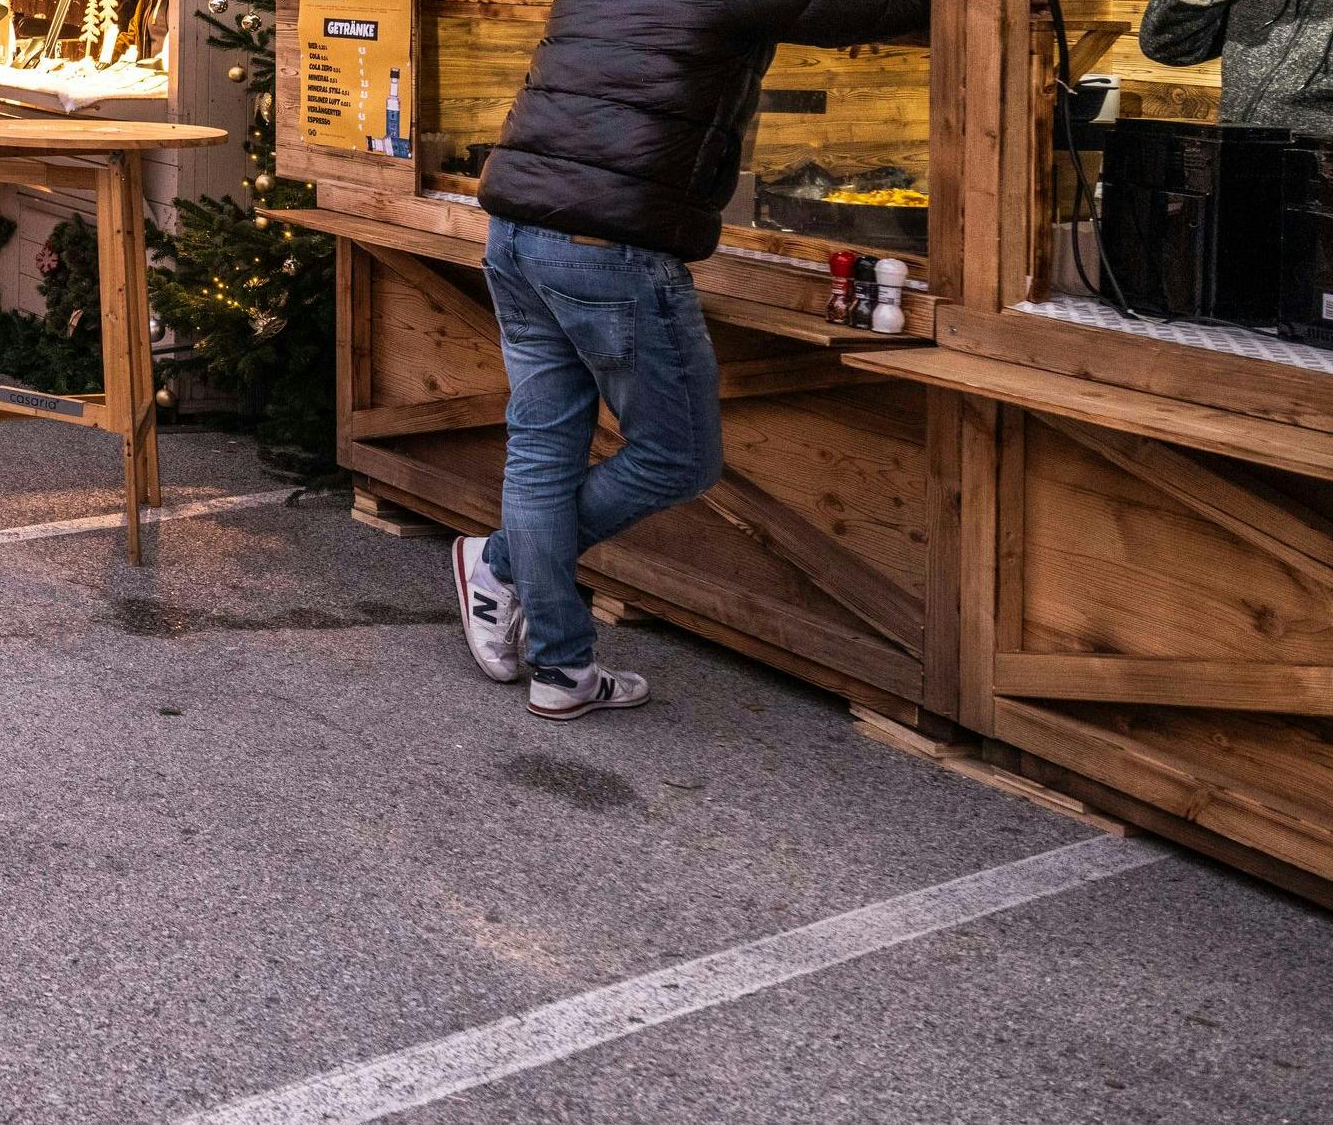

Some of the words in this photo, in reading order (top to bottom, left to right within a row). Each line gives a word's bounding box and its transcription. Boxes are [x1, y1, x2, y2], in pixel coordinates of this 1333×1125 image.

[328, 21, 375, 37] GETRÄNKE
[308, 74, 329, 82] MINERAL
[307, 116, 330, 125] ESPRESSO
[473, 591, 497, 625] N
[596, 677, 615, 700] N
